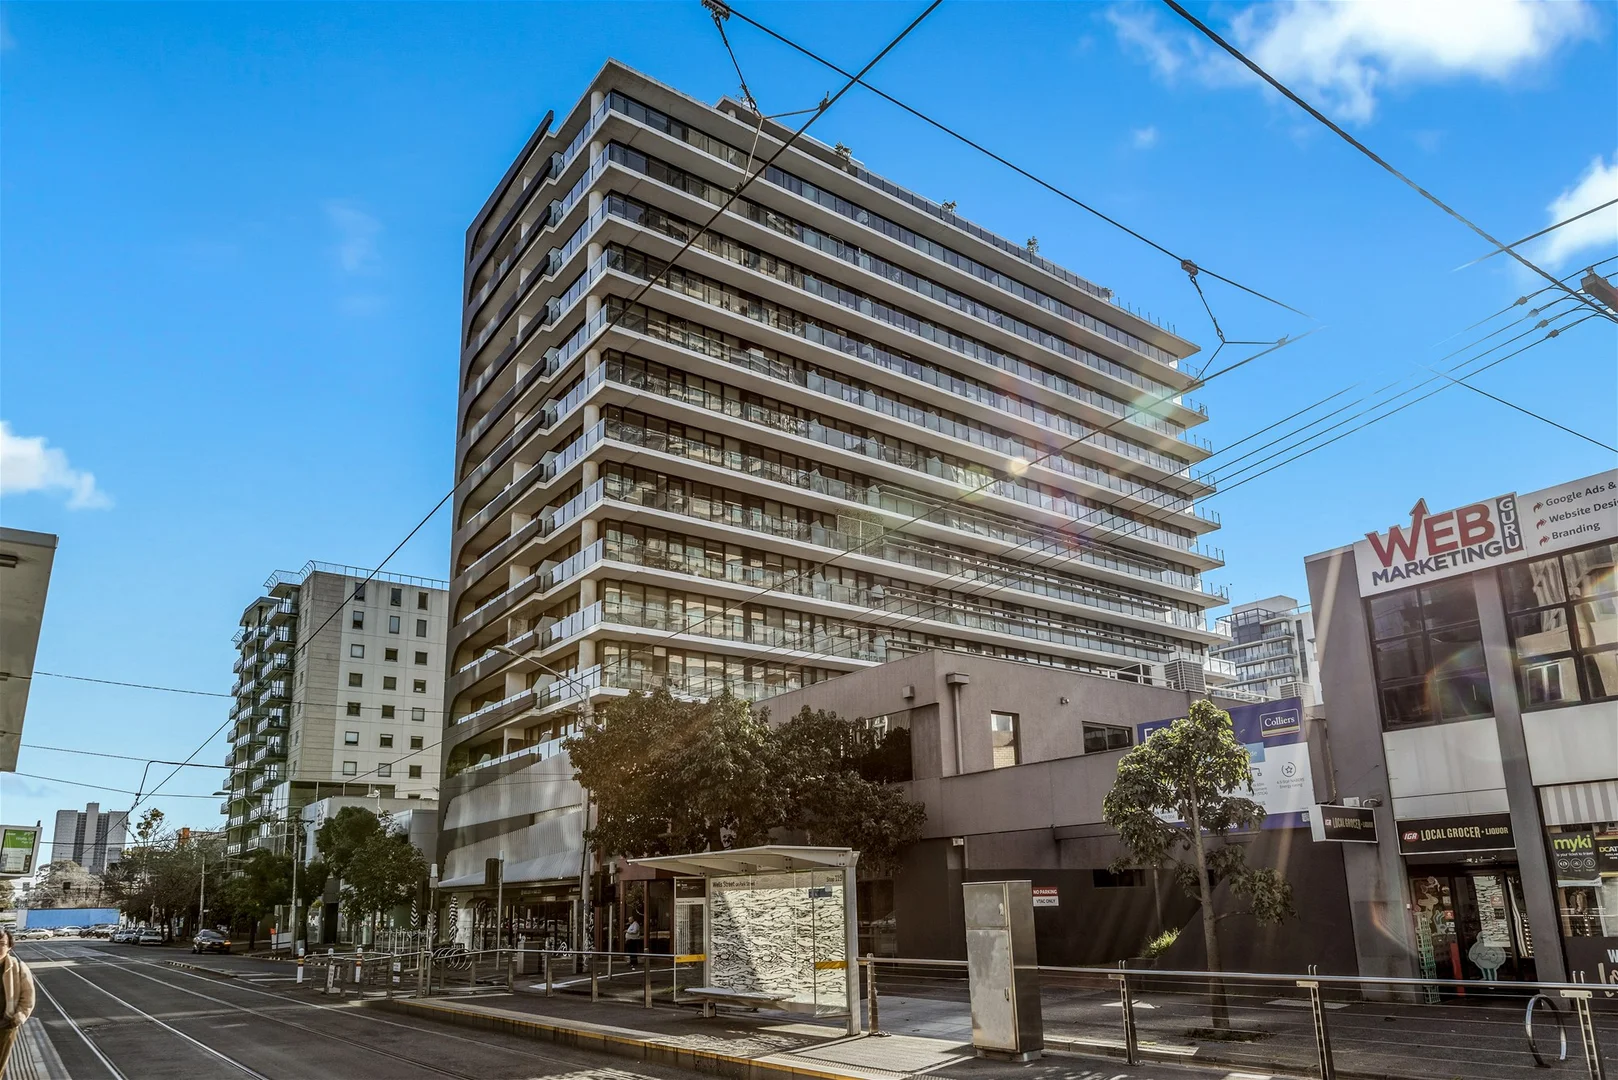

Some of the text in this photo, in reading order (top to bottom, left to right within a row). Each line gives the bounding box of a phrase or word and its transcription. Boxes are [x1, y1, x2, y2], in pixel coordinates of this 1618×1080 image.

[1545, 481, 1617, 506] Google Ads &
[1498, 497, 1521, 549] GURU
[1548, 498, 1618, 523] Website Desi
[1366, 500, 1496, 568] WEB
[1551, 522, 1601, 540] Branding
[1371, 540, 1503, 587] MARKETING
[1264, 716, 1295, 727] Colliers
[1404, 826, 1508, 841] IGA LOCAL GROCER LIQUOR
[1553, 834, 1592, 852] myki
